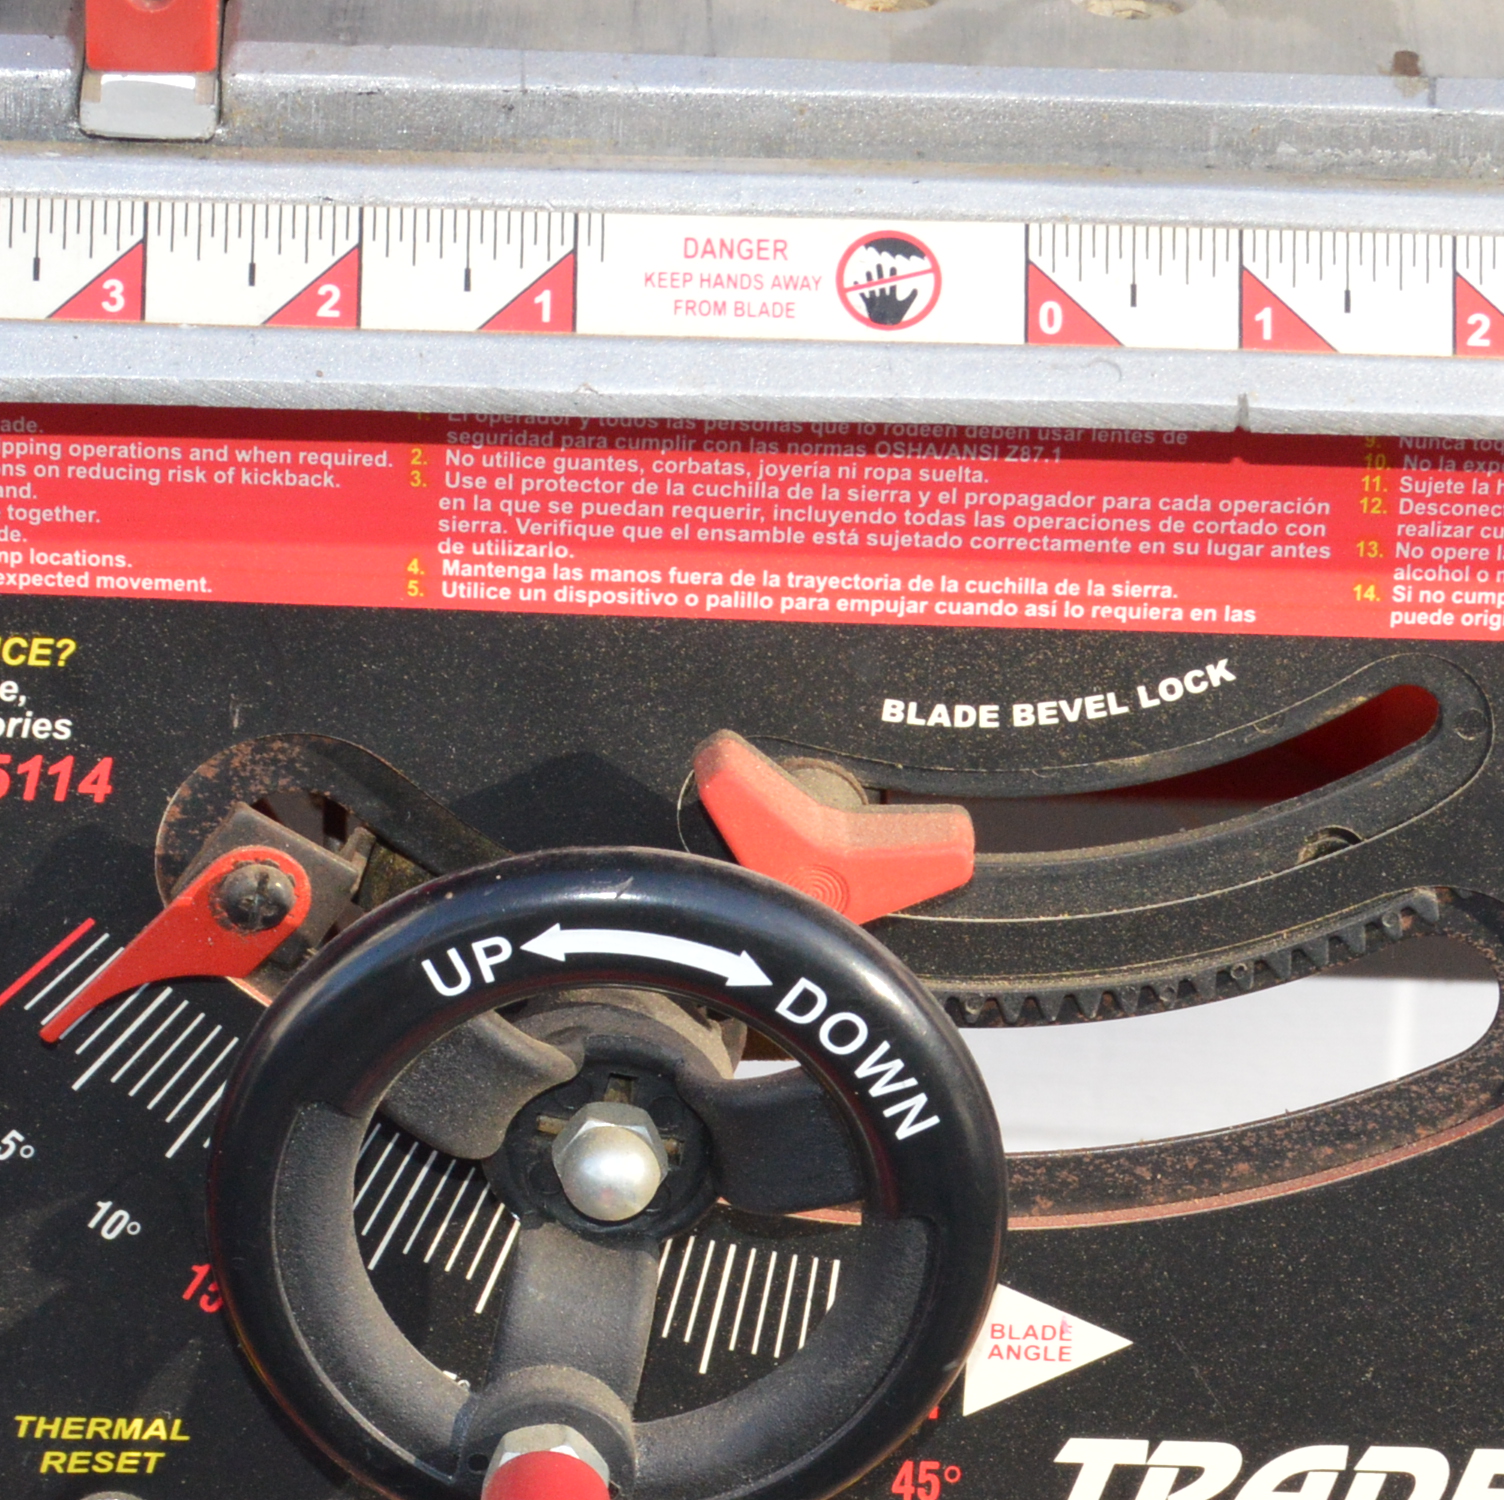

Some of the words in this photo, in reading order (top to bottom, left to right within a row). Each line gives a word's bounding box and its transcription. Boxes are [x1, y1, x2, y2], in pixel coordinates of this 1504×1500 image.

[684, 237, 787, 261] DANGER
[645, 271, 693, 289] KEEP
[700, 273, 764, 291] HANDS
[771, 274, 821, 291] AWAY
[102, 279, 125, 312] 3
[316, 284, 340, 317] 2
[534, 290, 551, 323] 1
[674, 299, 726, 317] FROM
[734, 300, 795, 319] BLADE
[1039, 301, 1063, 335] 0
[1254, 307, 1272, 340] 1
[1466, 313, 1491, 347] 2
[411, 448, 427, 465] 2.
[446, 449, 474, 467] No
[482, 451, 546, 469] utilice
[553, 455, 644, 475] guantes,
[652, 457, 750, 479] corbatas,
[757, 459, 830, 482] joyería
[838, 463, 856, 480] ni
[864, 467, 911, 485] ropa
[919, 466, 988, 483] suelta.
[1362, 475, 1387, 492] 11.
[1400, 476, 1465, 498] Sujete
[1472, 478, 1489, 495] la
[30, 548, 132, 568] locations.
[96, 575, 212, 593] movement.
[1390, 608, 1454, 629] puede
[881, 699, 999, 728] BLADE
[1012, 692, 1129, 727] BEVEL
[1137, 659, 1236, 708] LOCK
[422, 936, 512, 996] UP
[776, 977, 940, 1140] DOWN
[989, 1323, 1072, 1342] BLADE
[987, 1344, 1072, 1362] ANGLE
[15, 1415, 189, 1441] THERMAL
[40, 1451, 165, 1474] RESET
